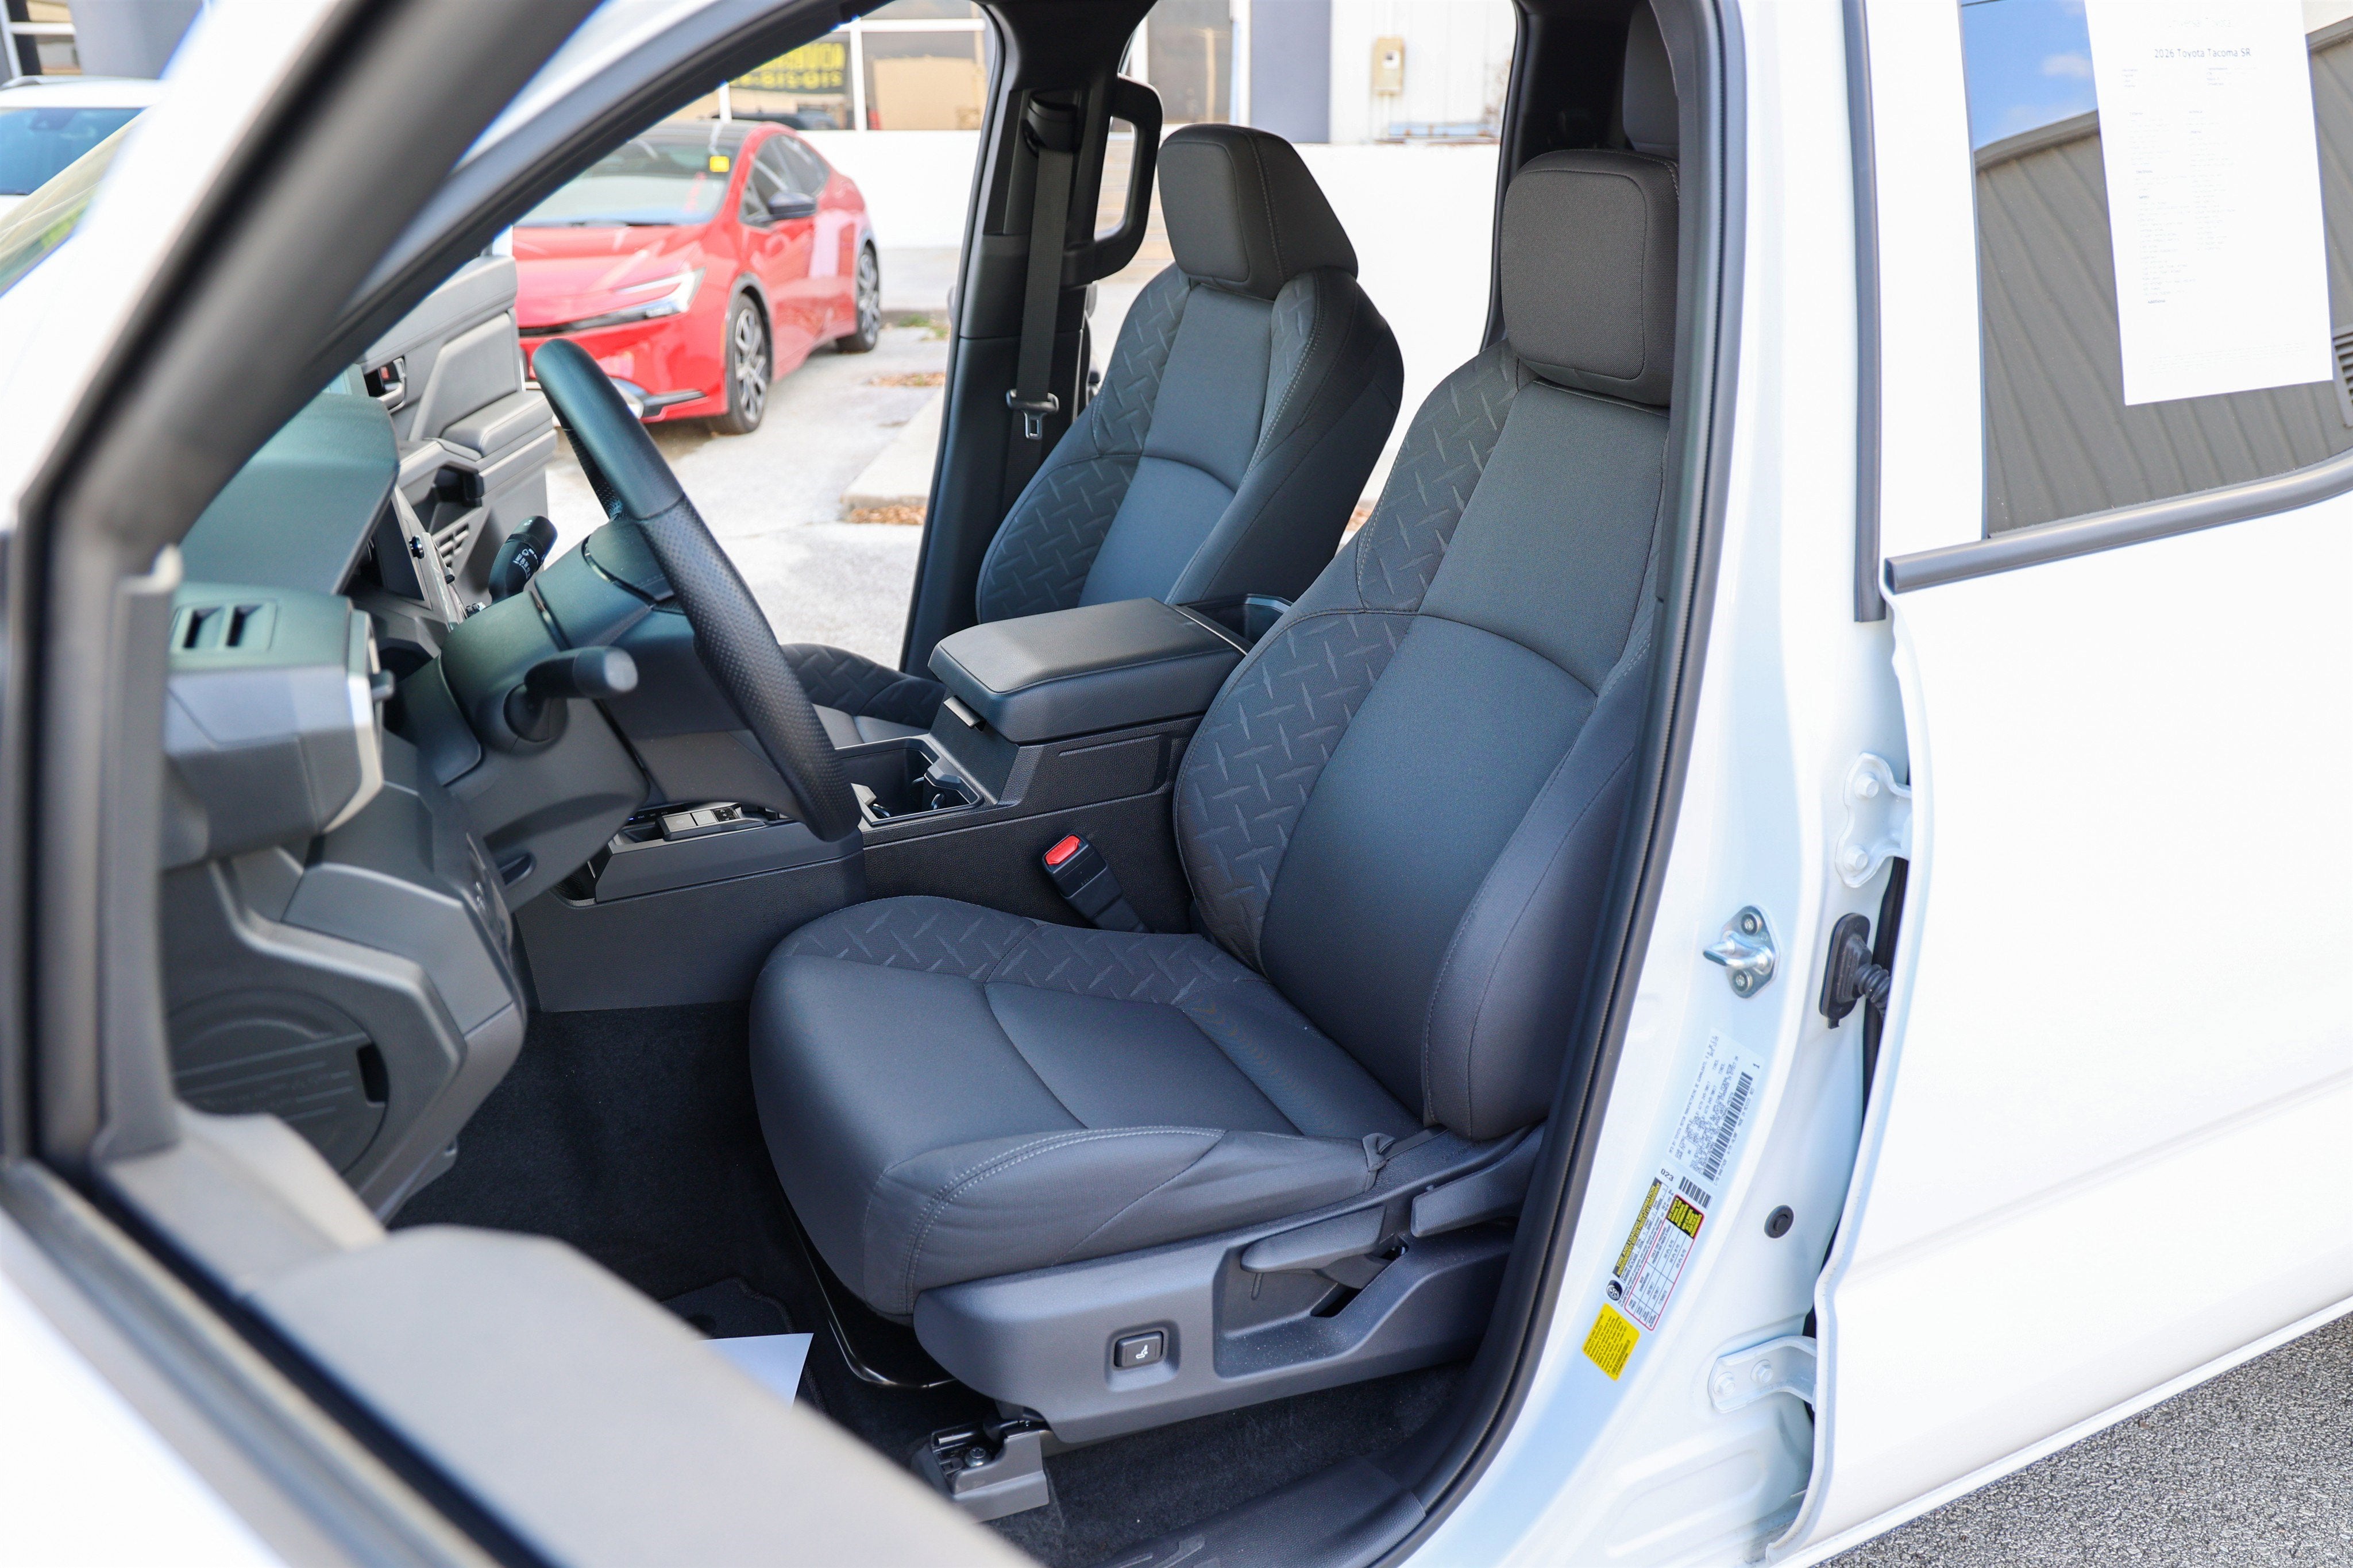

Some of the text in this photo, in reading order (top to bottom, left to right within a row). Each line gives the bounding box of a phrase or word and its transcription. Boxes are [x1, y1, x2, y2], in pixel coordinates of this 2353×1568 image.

[2154, 48, 2251, 59] 2026 Toyota Tacoma SR
[1661, 1168, 1674, 1181] 023
[1627, 1220, 1640, 1245] LOADING
[1637, 1184, 1656, 1221] INFORMATION
